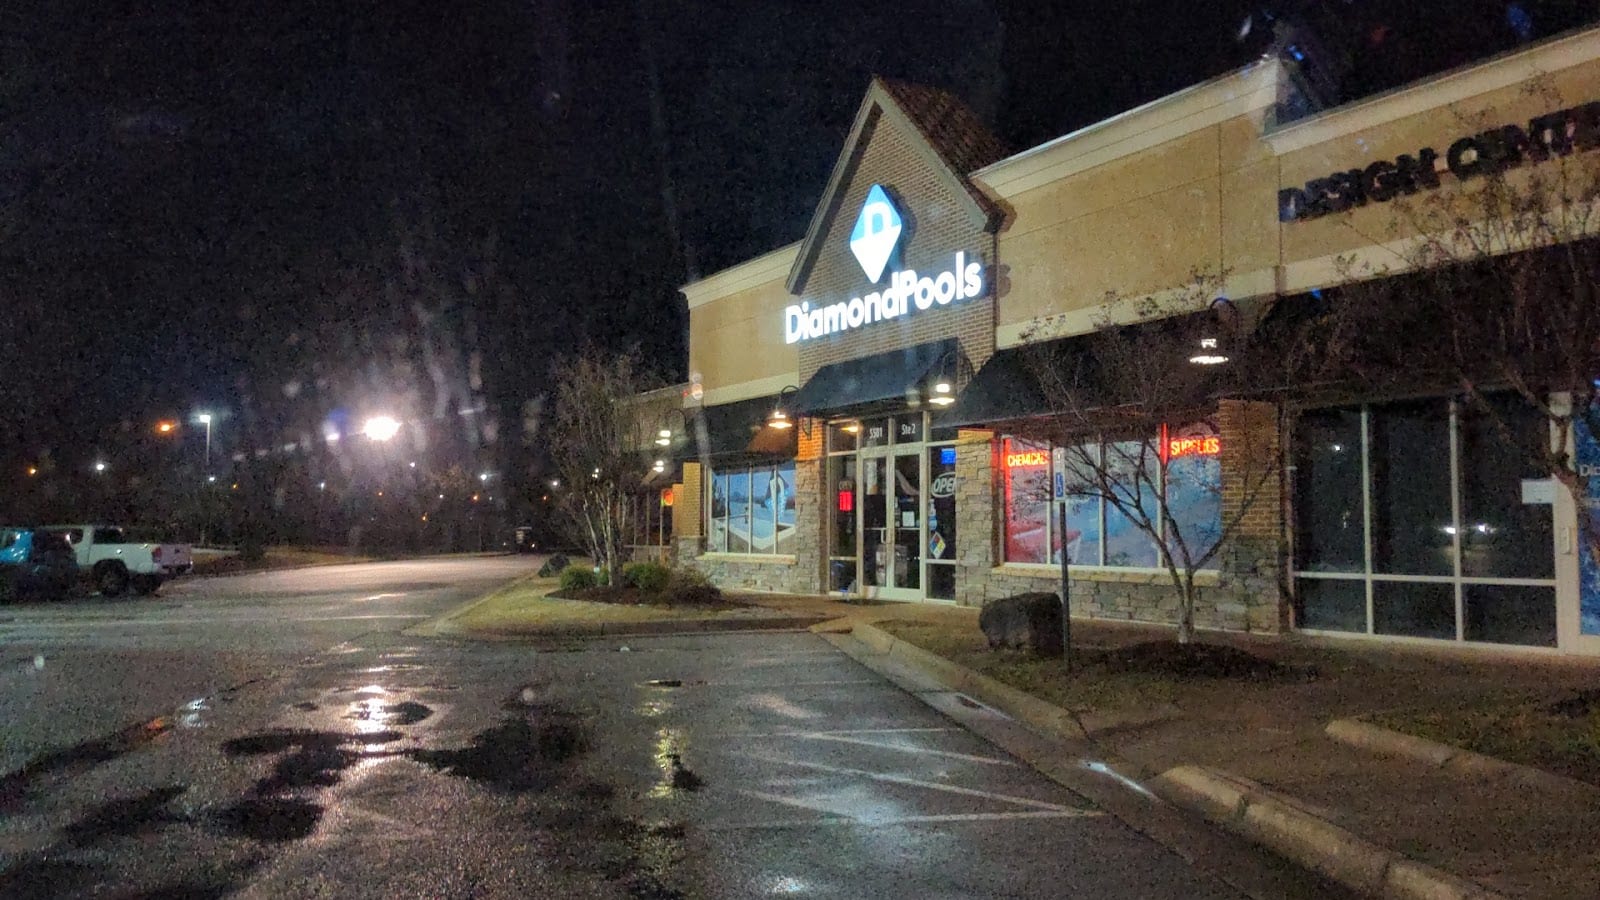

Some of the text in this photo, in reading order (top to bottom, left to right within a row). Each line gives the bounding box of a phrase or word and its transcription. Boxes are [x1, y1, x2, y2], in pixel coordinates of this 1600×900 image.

[1278, 147, 1441, 222] DESIGN
[784, 251, 982, 345] DiamondPools
[901, 423, 912, 436] Ste
[912, 423, 917, 434] 2
